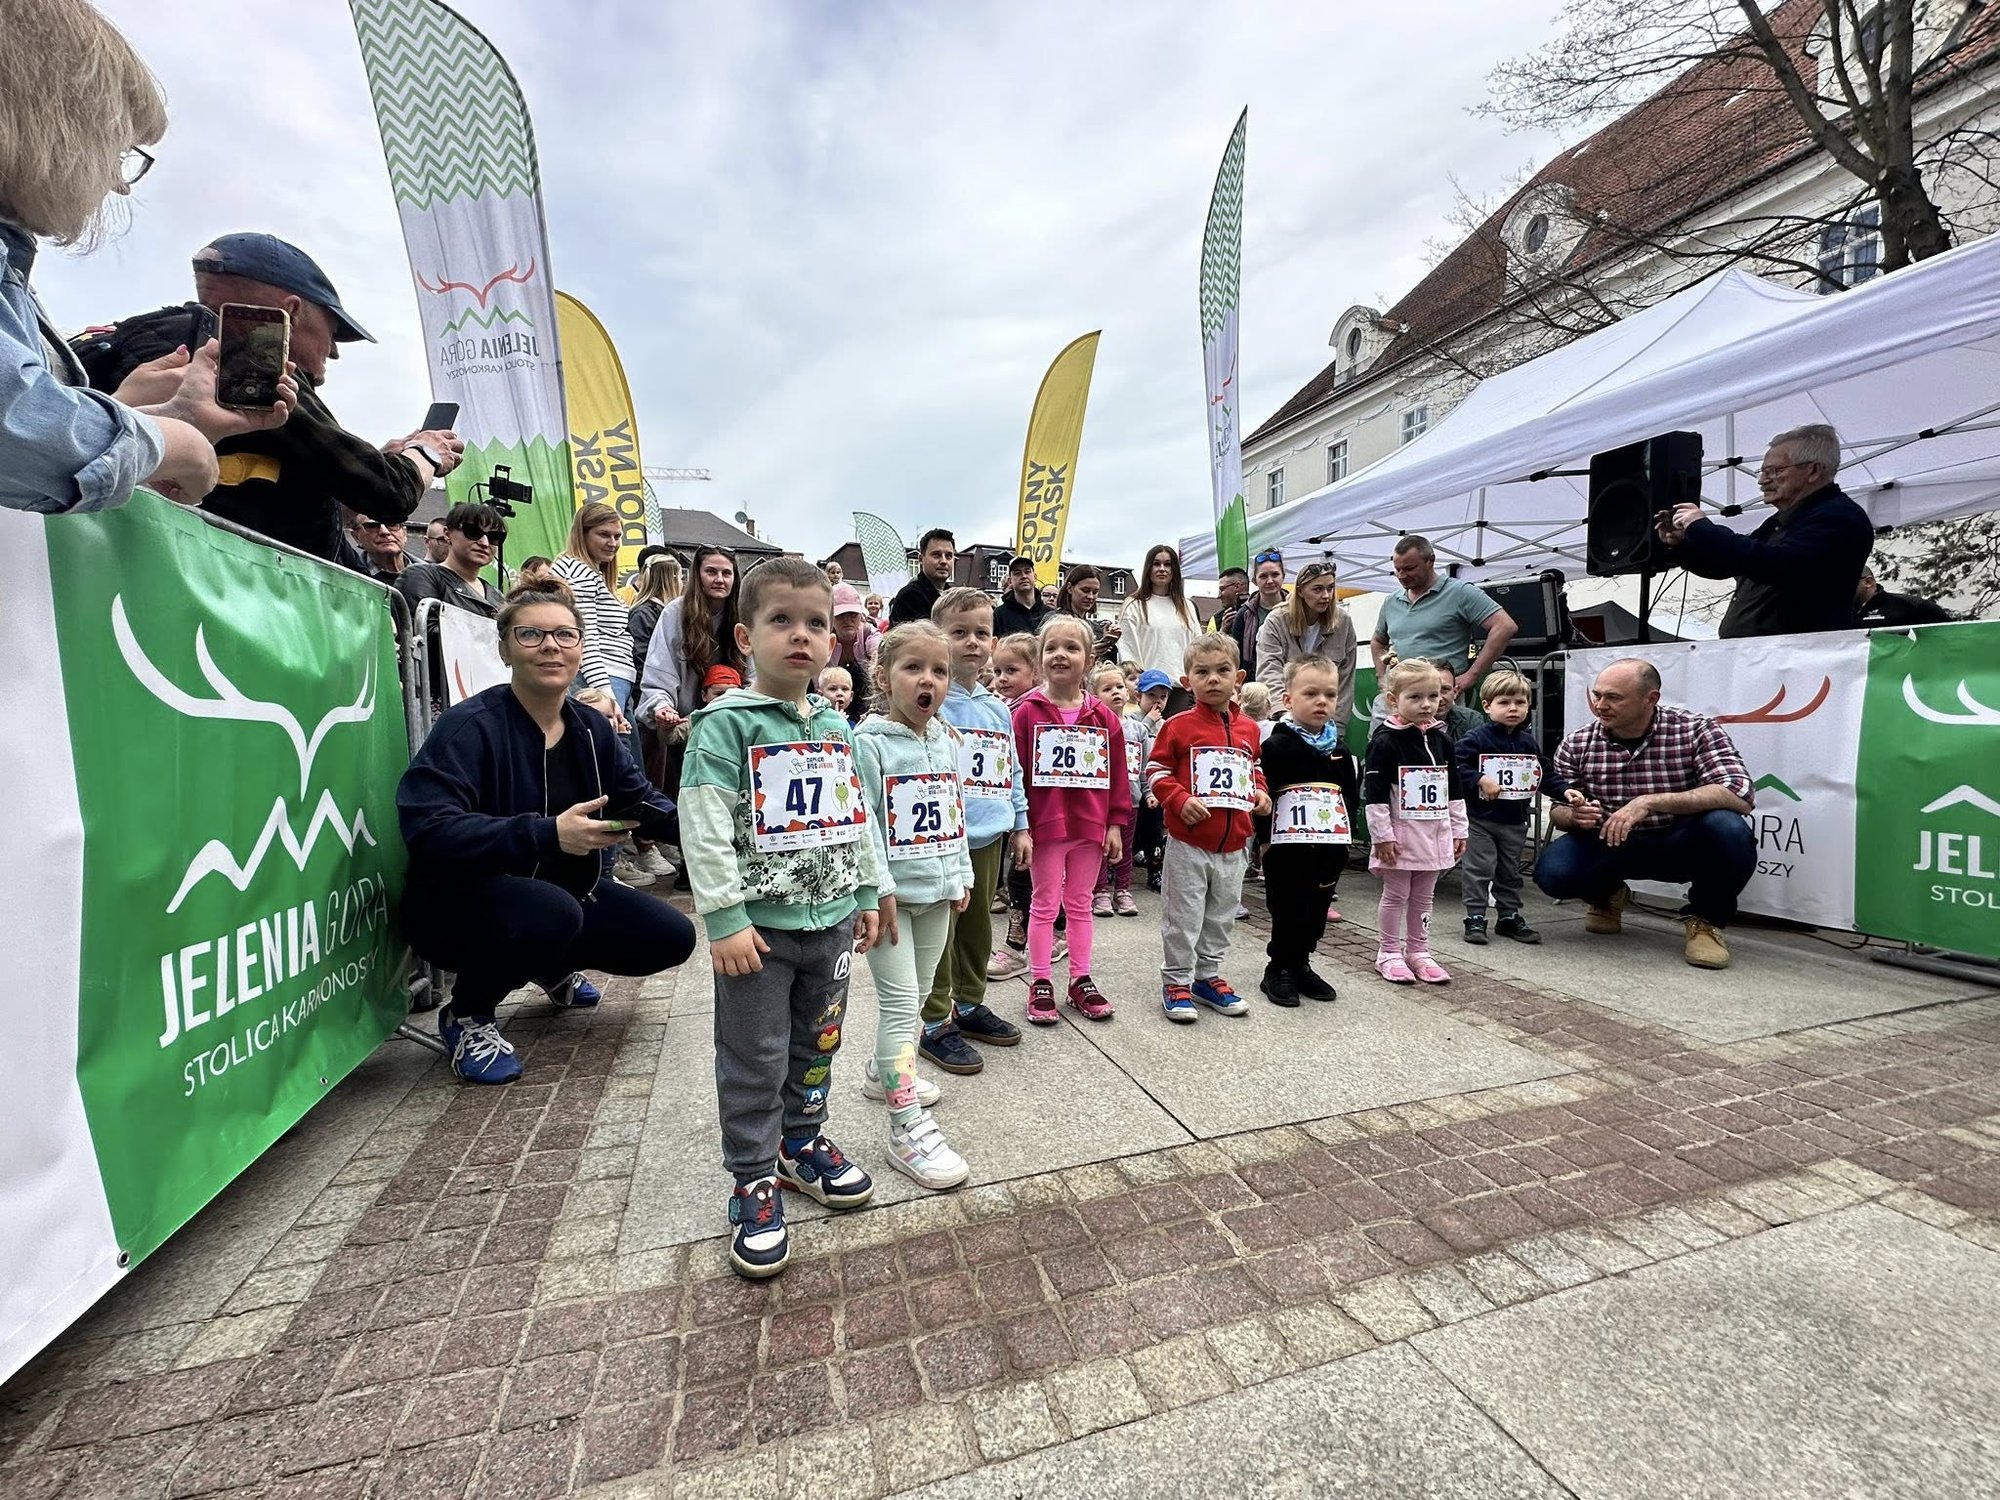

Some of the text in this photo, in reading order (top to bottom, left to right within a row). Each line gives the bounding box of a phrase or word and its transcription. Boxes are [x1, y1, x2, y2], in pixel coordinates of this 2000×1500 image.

[1021, 460, 1047, 560] DOLNY
[972, 753, 984, 777] 3
[1052, 746, 1076, 768] 26
[1210, 768, 1233, 789] 23
[1496, 770, 1513, 786] 13
[786, 777, 822, 816] 47
[1419, 785, 1437, 803] 16
[912, 801, 941, 832] 25
[1290, 805, 1306, 825] 11
[1748, 813, 1805, 855] RA
[1913, 830, 2000, 879] JEL
[1930, 884, 2000, 909] STOL
[159, 900, 321, 1048] JELENIA
[184, 1014, 280, 1097] STOLICA
